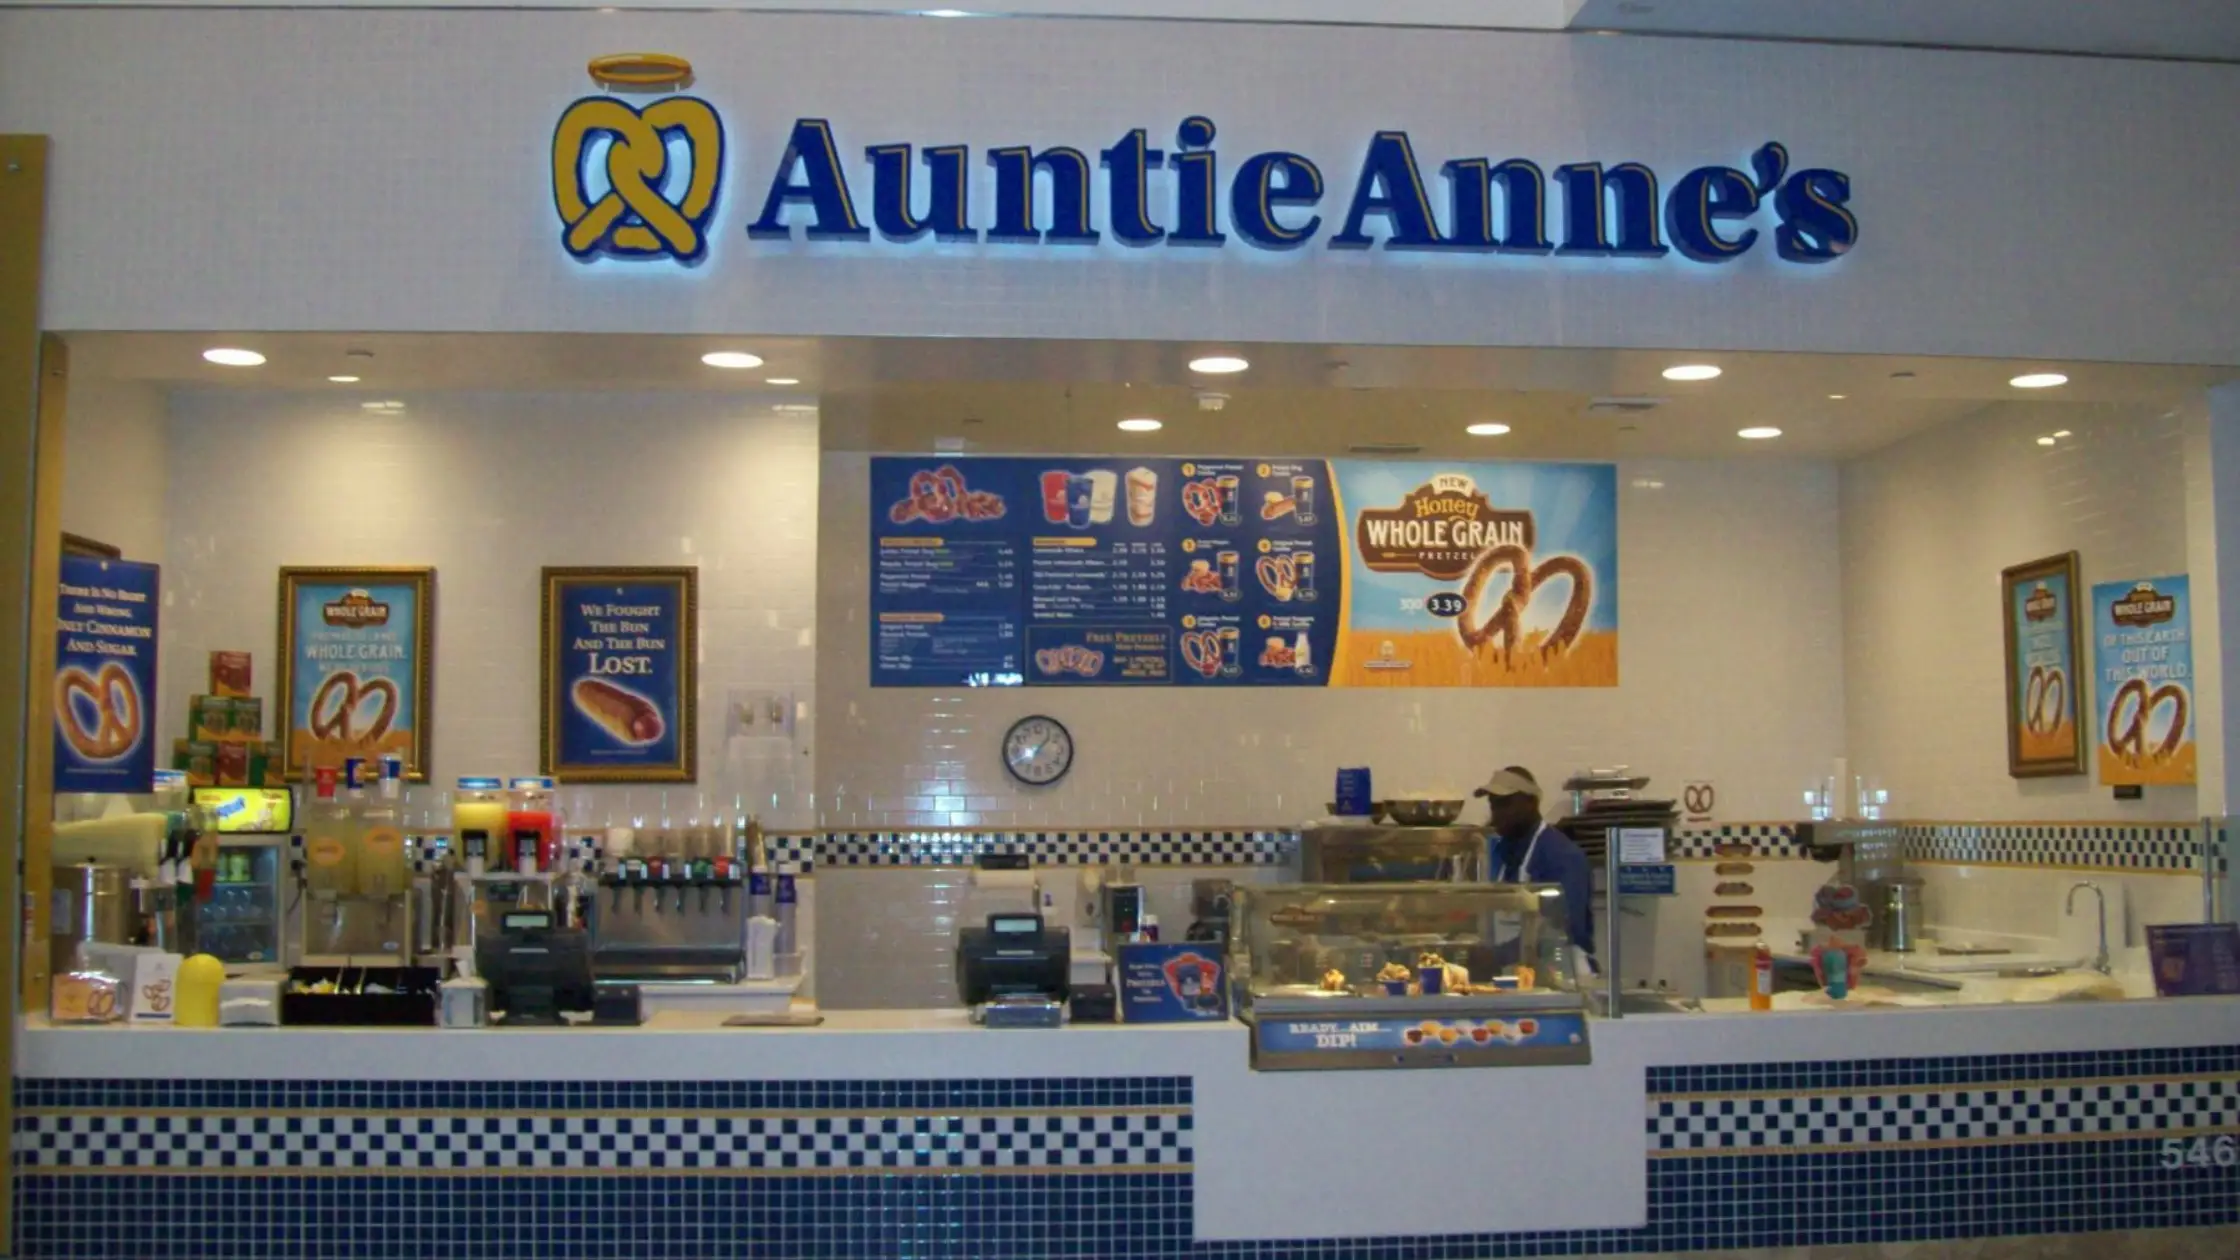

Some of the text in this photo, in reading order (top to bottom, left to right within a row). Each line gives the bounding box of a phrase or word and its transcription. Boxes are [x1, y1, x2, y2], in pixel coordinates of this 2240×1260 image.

[747, 115, 1859, 263] Auntie Anne's
[1438, 476, 1470, 489] NEW
[1415, 496, 1480, 522] Honey
[1366, 519, 1525, 549] WHOLE GRAIN
[1431, 598, 1463, 613] 3.39
[306, 644, 355, 660] WHOLE
[589, 651, 654, 675] LOST.
[1315, 1033, 1358, 1049] DIP!
[2159, 1134, 2237, 1170] 546
